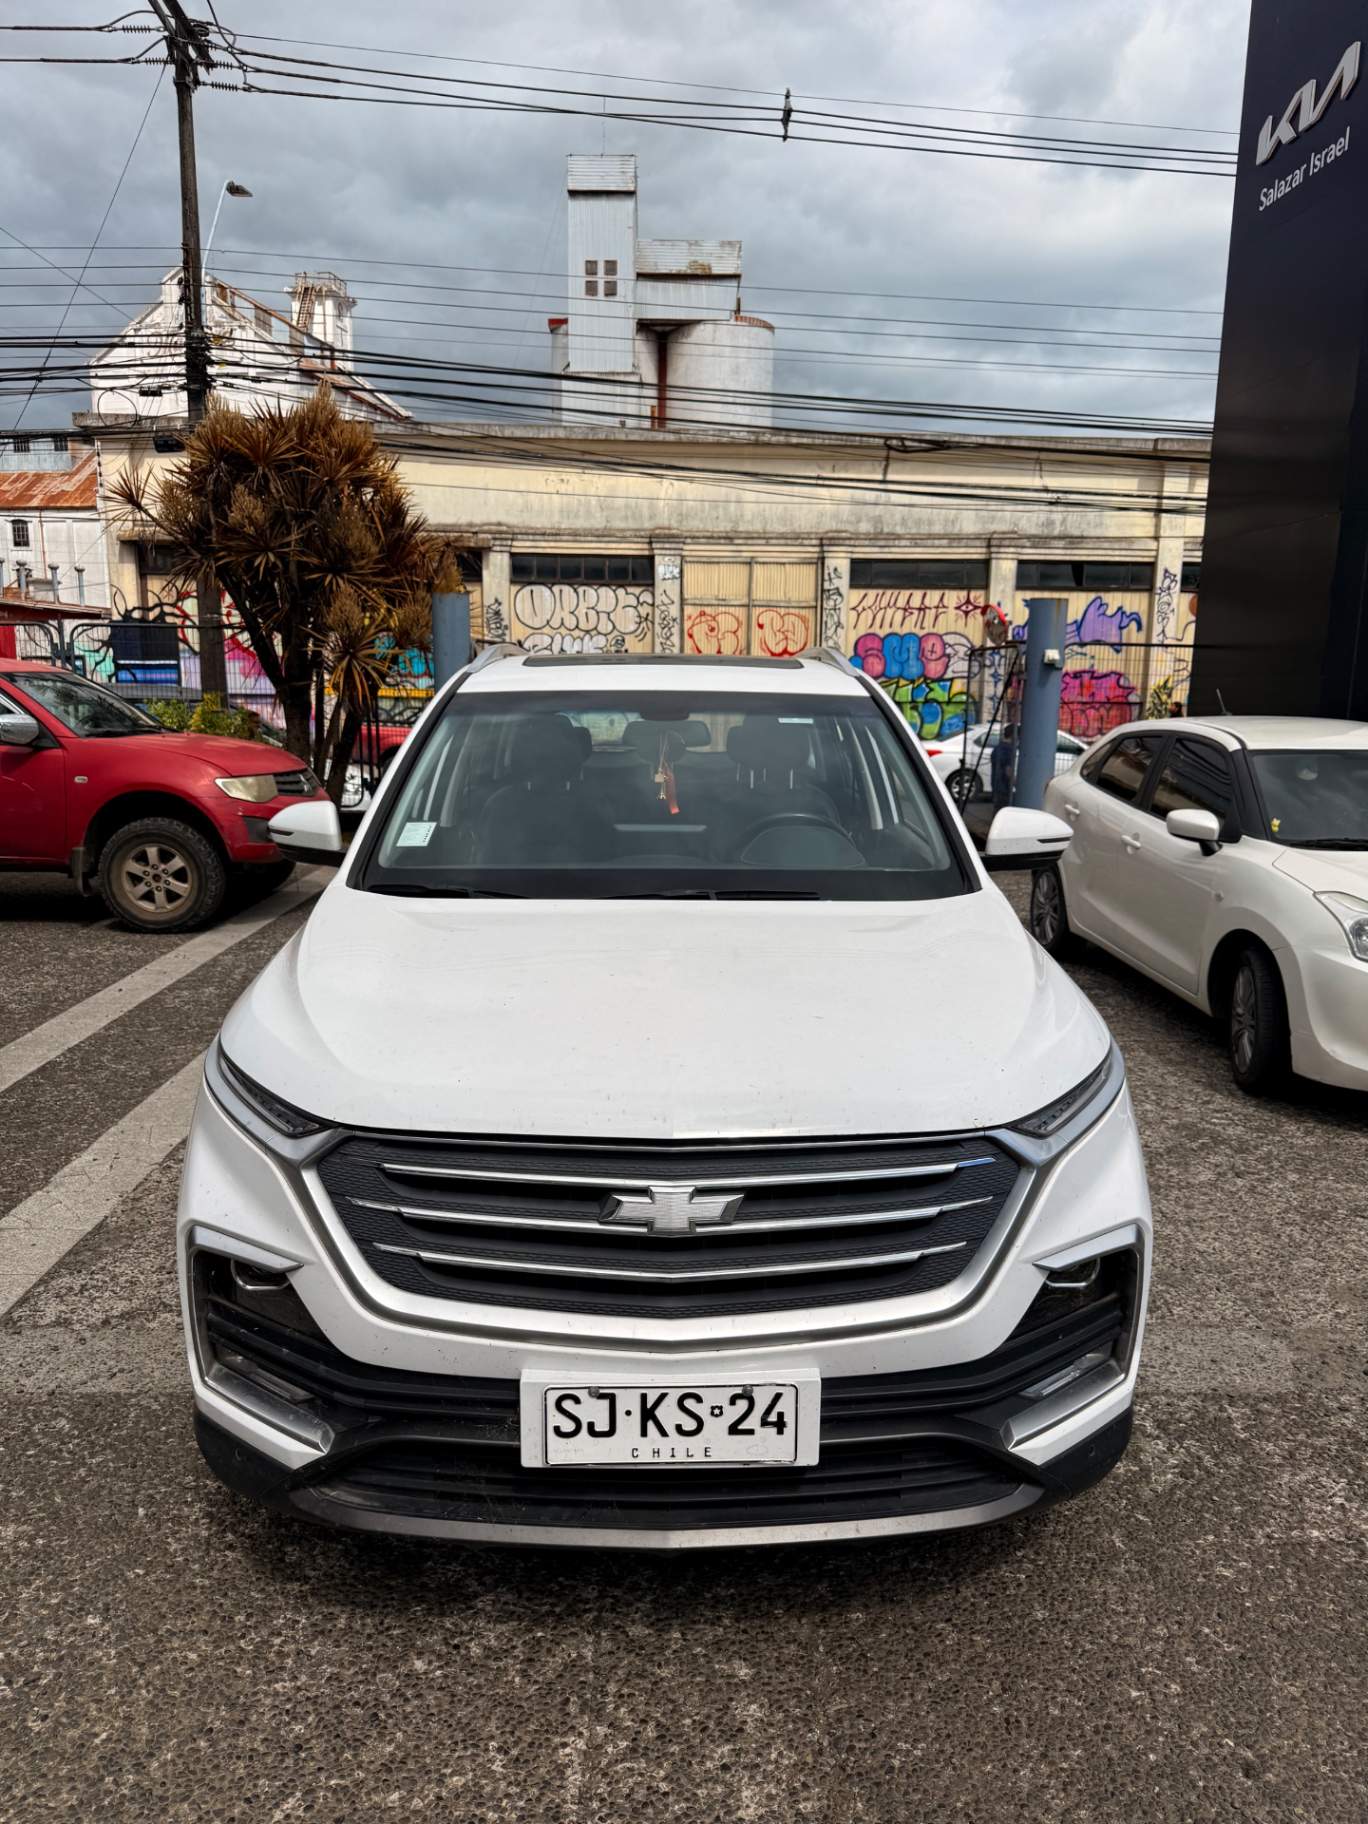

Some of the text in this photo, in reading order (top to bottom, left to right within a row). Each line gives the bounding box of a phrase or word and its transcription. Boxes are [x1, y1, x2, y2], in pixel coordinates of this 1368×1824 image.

[1259, 126, 1350, 211] Salazar Israel
[631, 1447, 712, 1458] CHILE
